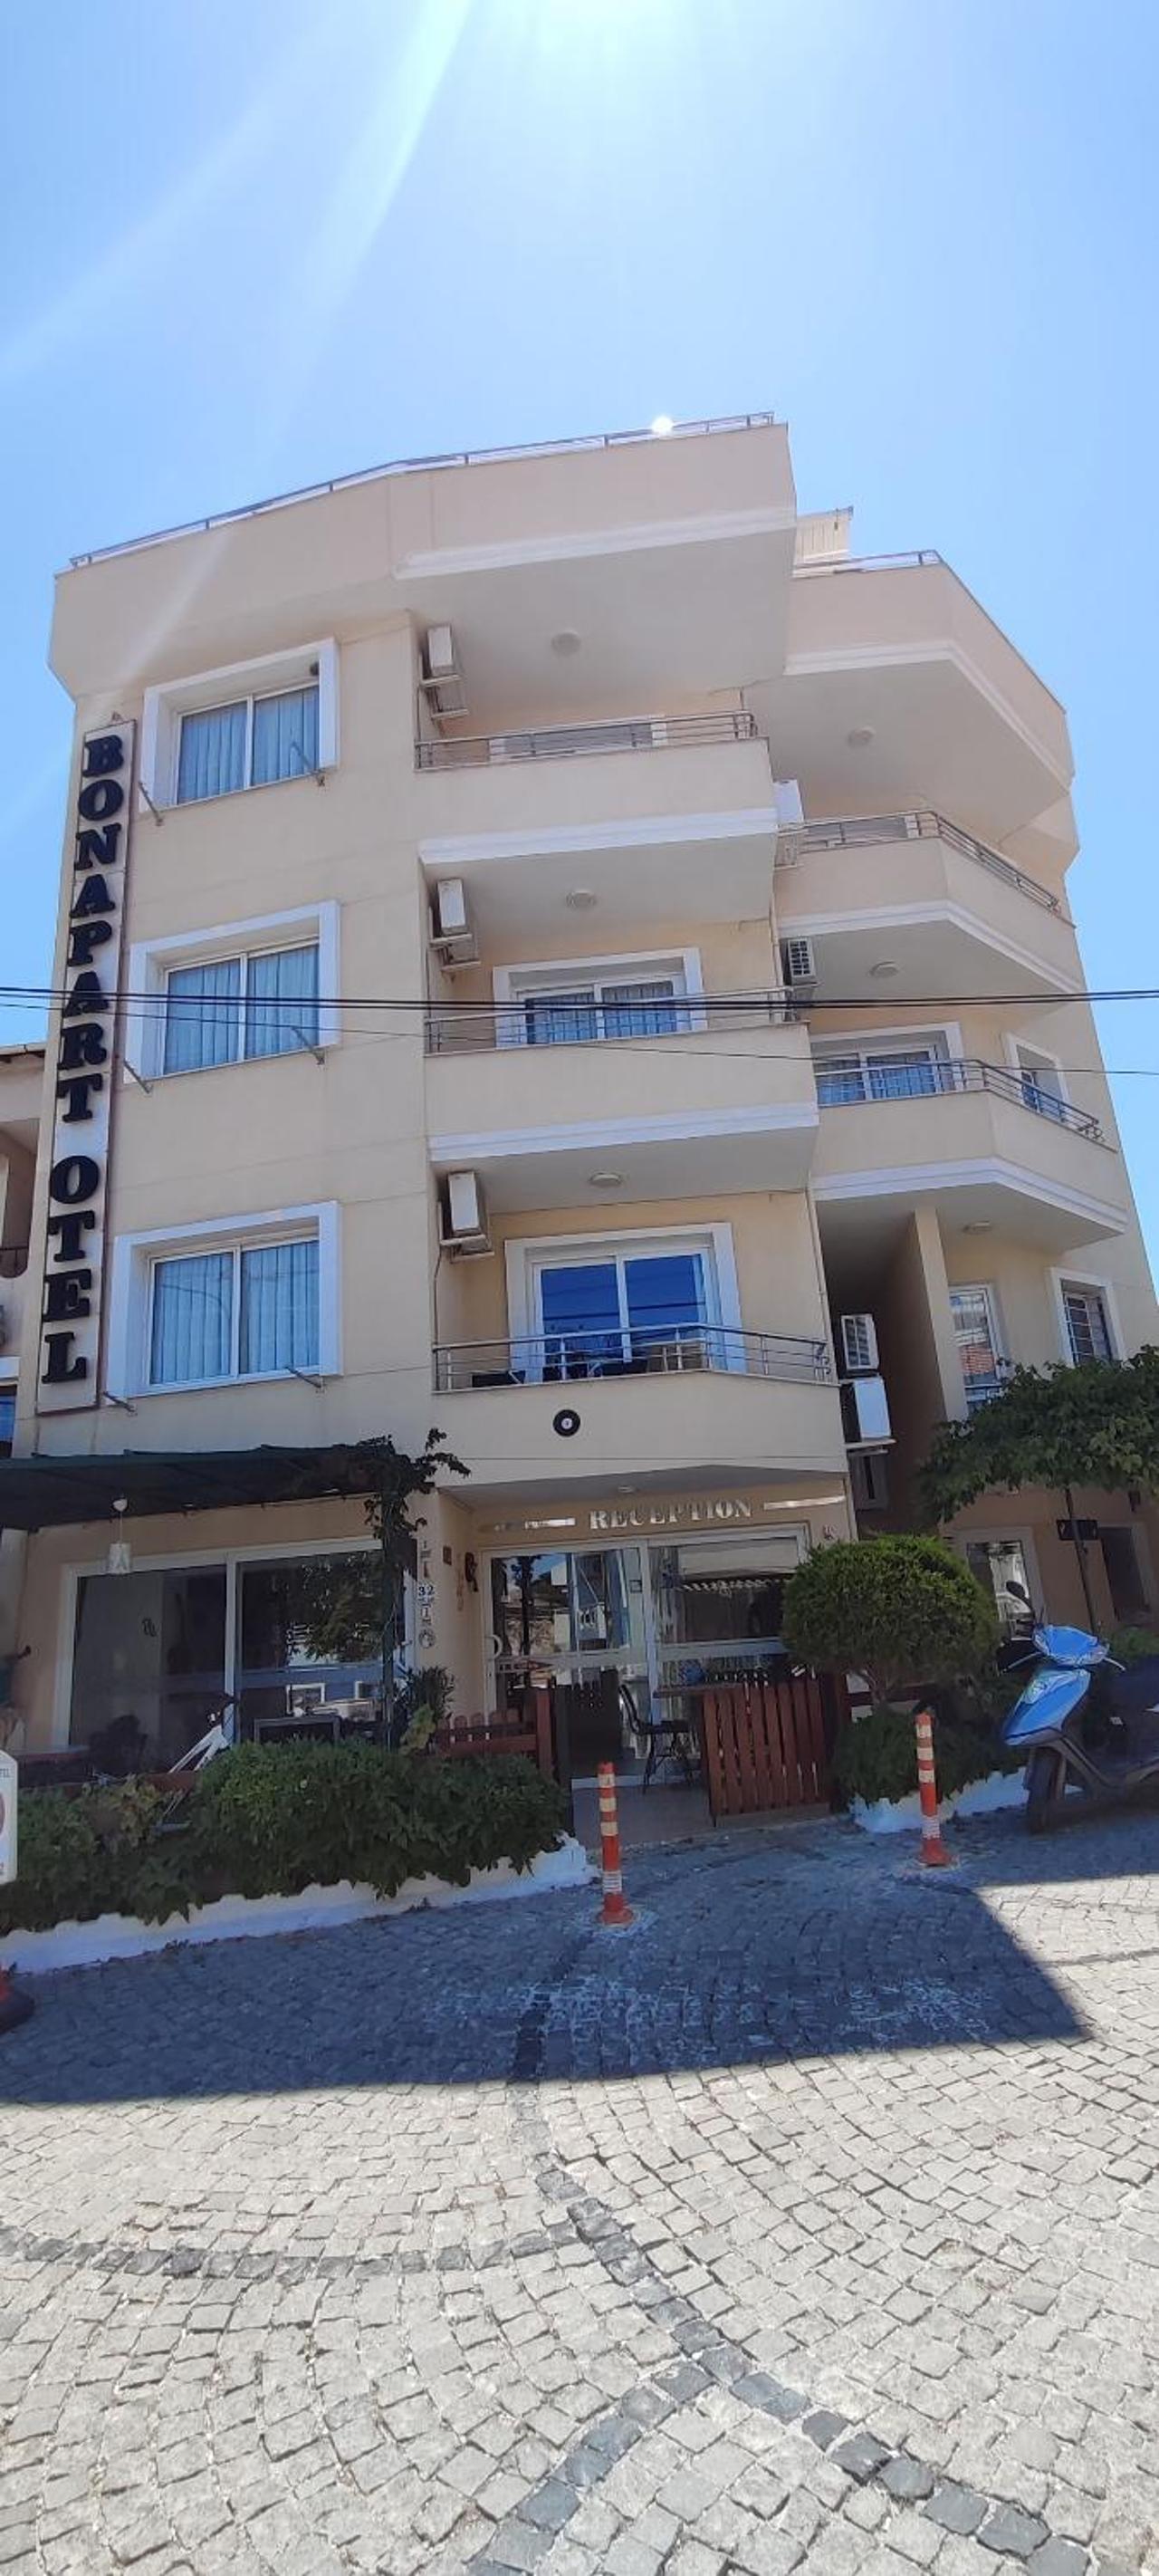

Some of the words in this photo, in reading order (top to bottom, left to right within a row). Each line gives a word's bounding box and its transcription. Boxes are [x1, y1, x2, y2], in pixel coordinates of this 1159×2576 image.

[56, 735, 124, 1122] BONAPART
[42, 1155, 100, 1385] OTEL
[589, 1499, 752, 1530] RECEPTION
